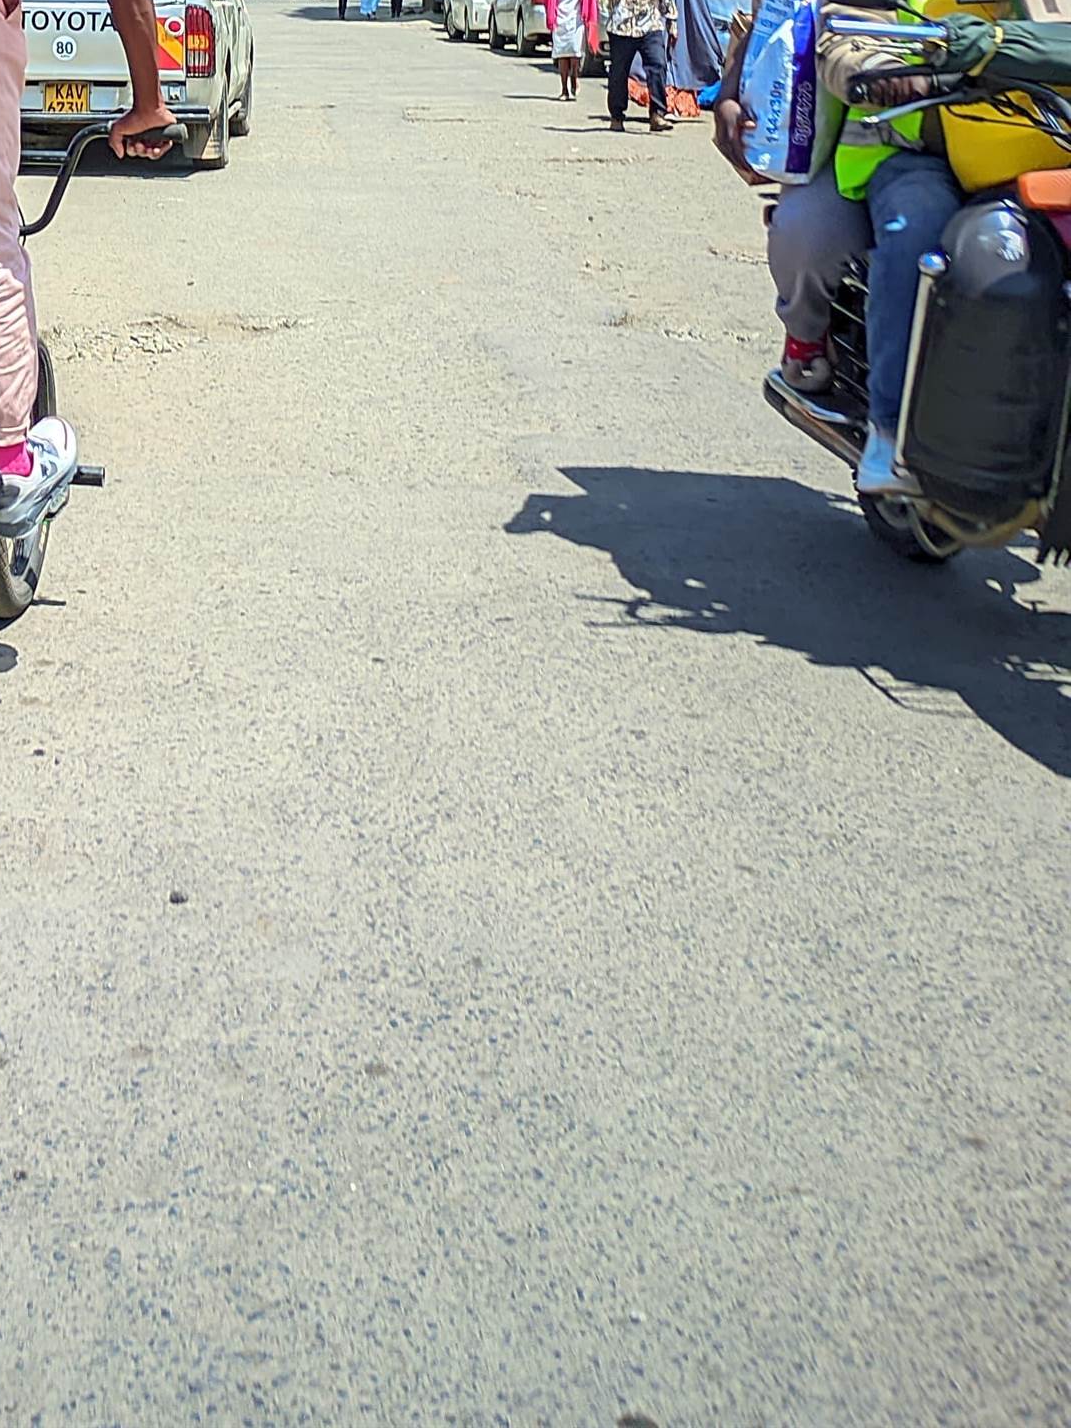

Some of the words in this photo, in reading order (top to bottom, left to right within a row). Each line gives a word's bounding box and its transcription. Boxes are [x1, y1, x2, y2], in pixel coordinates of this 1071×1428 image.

[21, 10, 117, 32] TOYOTA
[56, 41, 74, 55] 80
[55, 83, 85, 100] KAV
